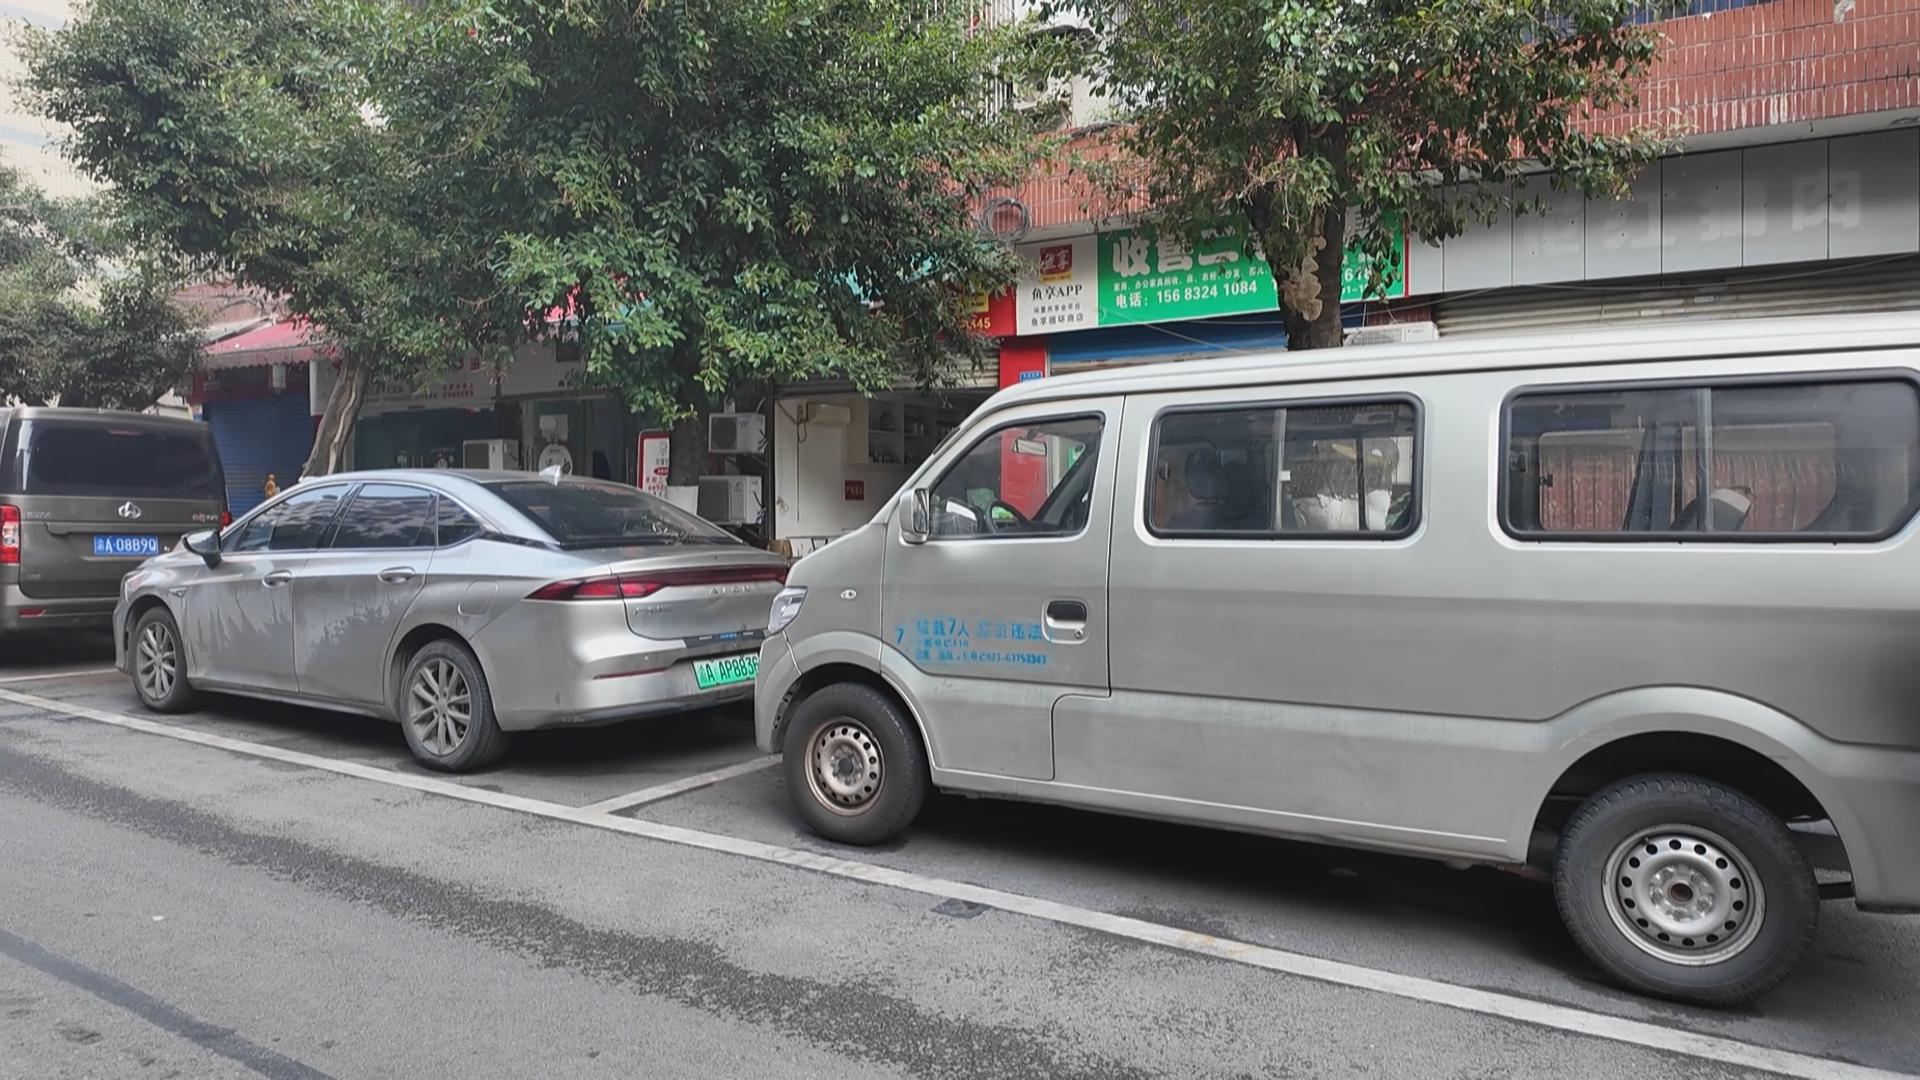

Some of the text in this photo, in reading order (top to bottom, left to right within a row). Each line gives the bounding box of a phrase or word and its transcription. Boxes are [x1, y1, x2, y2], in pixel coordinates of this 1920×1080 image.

[1157, 288, 1181, 304] 156
[1184, 285, 1218, 301] 8324
[1223, 280, 1258, 297] 1084
